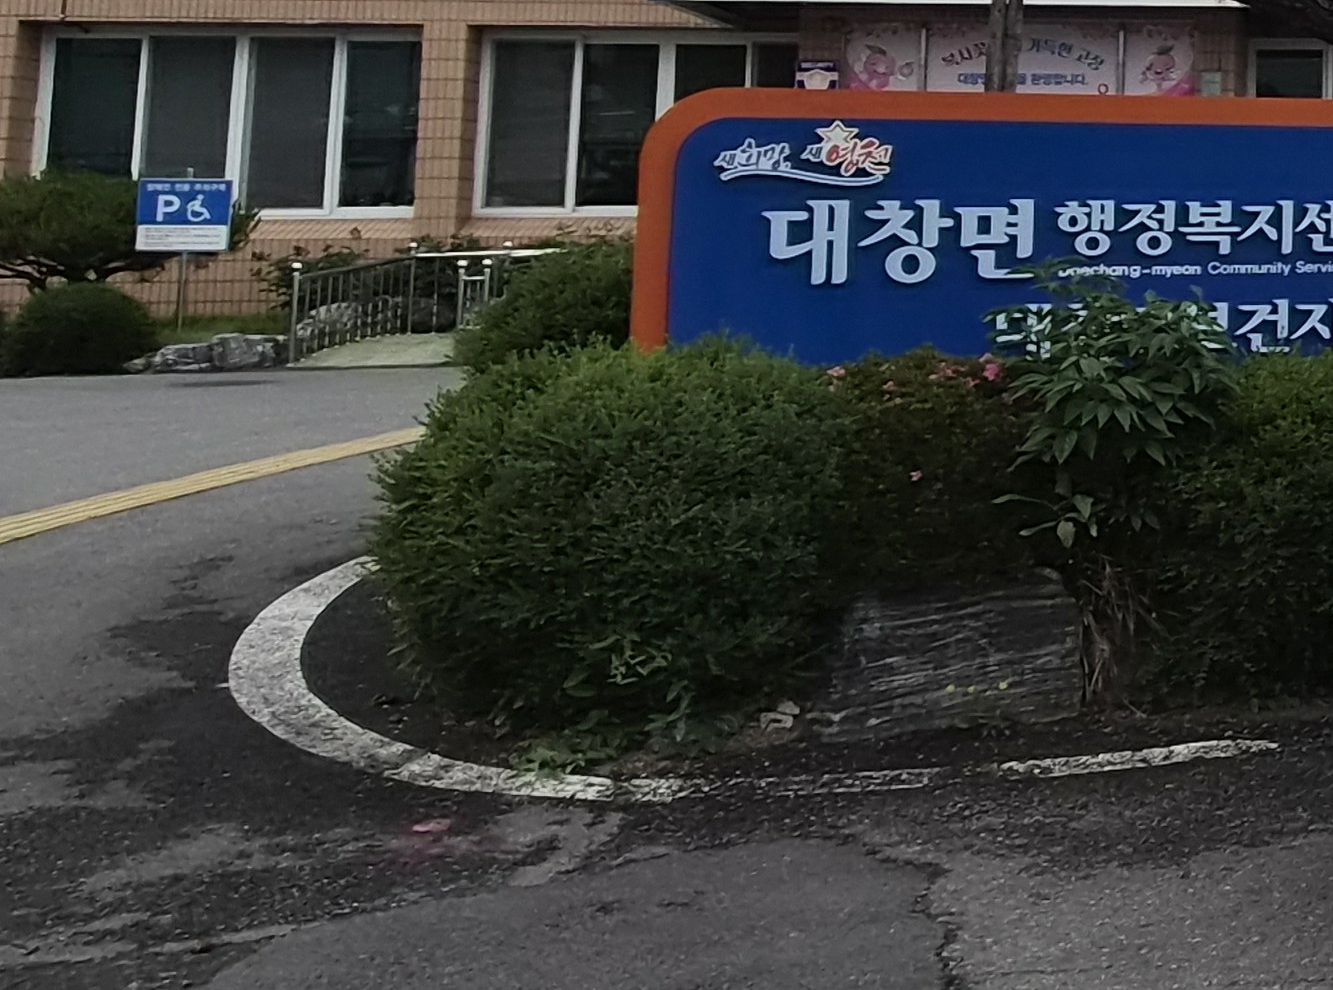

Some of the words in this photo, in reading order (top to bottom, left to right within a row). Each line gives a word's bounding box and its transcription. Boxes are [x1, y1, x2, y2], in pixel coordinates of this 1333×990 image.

[156, 194, 181, 222] P
[760, 198, 1036, 286] 대창면
[1207, 260, 1292, 277] Community
